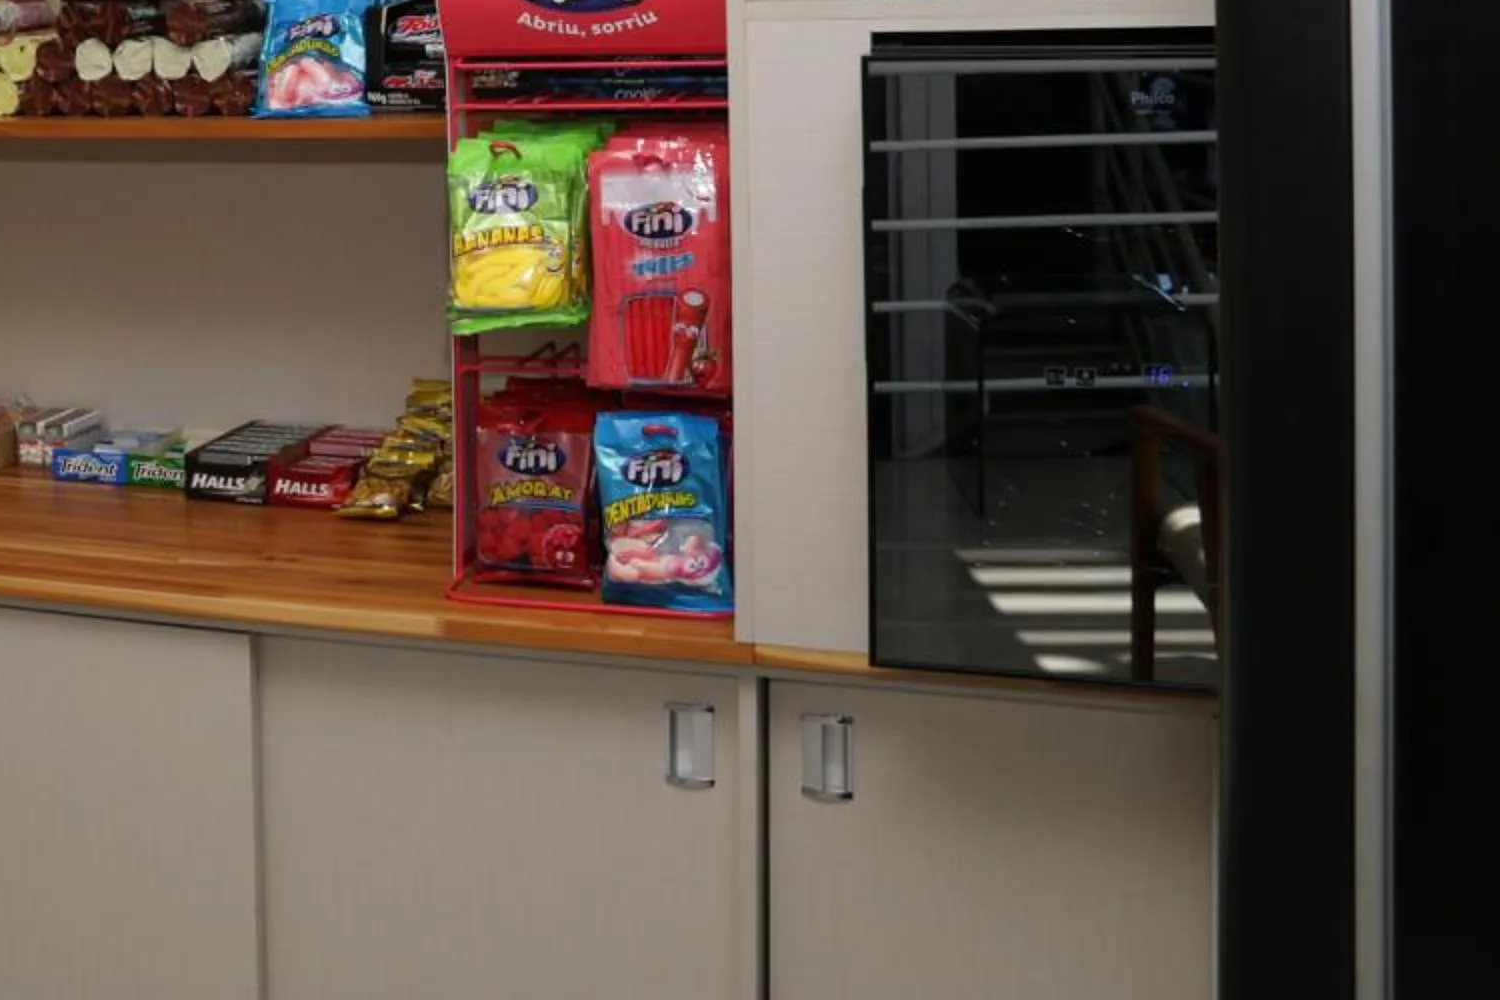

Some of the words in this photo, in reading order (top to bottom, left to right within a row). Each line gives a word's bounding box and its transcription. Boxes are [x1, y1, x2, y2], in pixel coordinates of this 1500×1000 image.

[516, 11, 586, 37] Abriu,
[591, 11, 659, 36] sorriu
[631, 203, 684, 234] Fini
[506, 438, 557, 470] Fini
[626, 450, 681, 484] Fini
[191, 472, 245, 491] HALLS
[273, 479, 329, 497] HALLS
